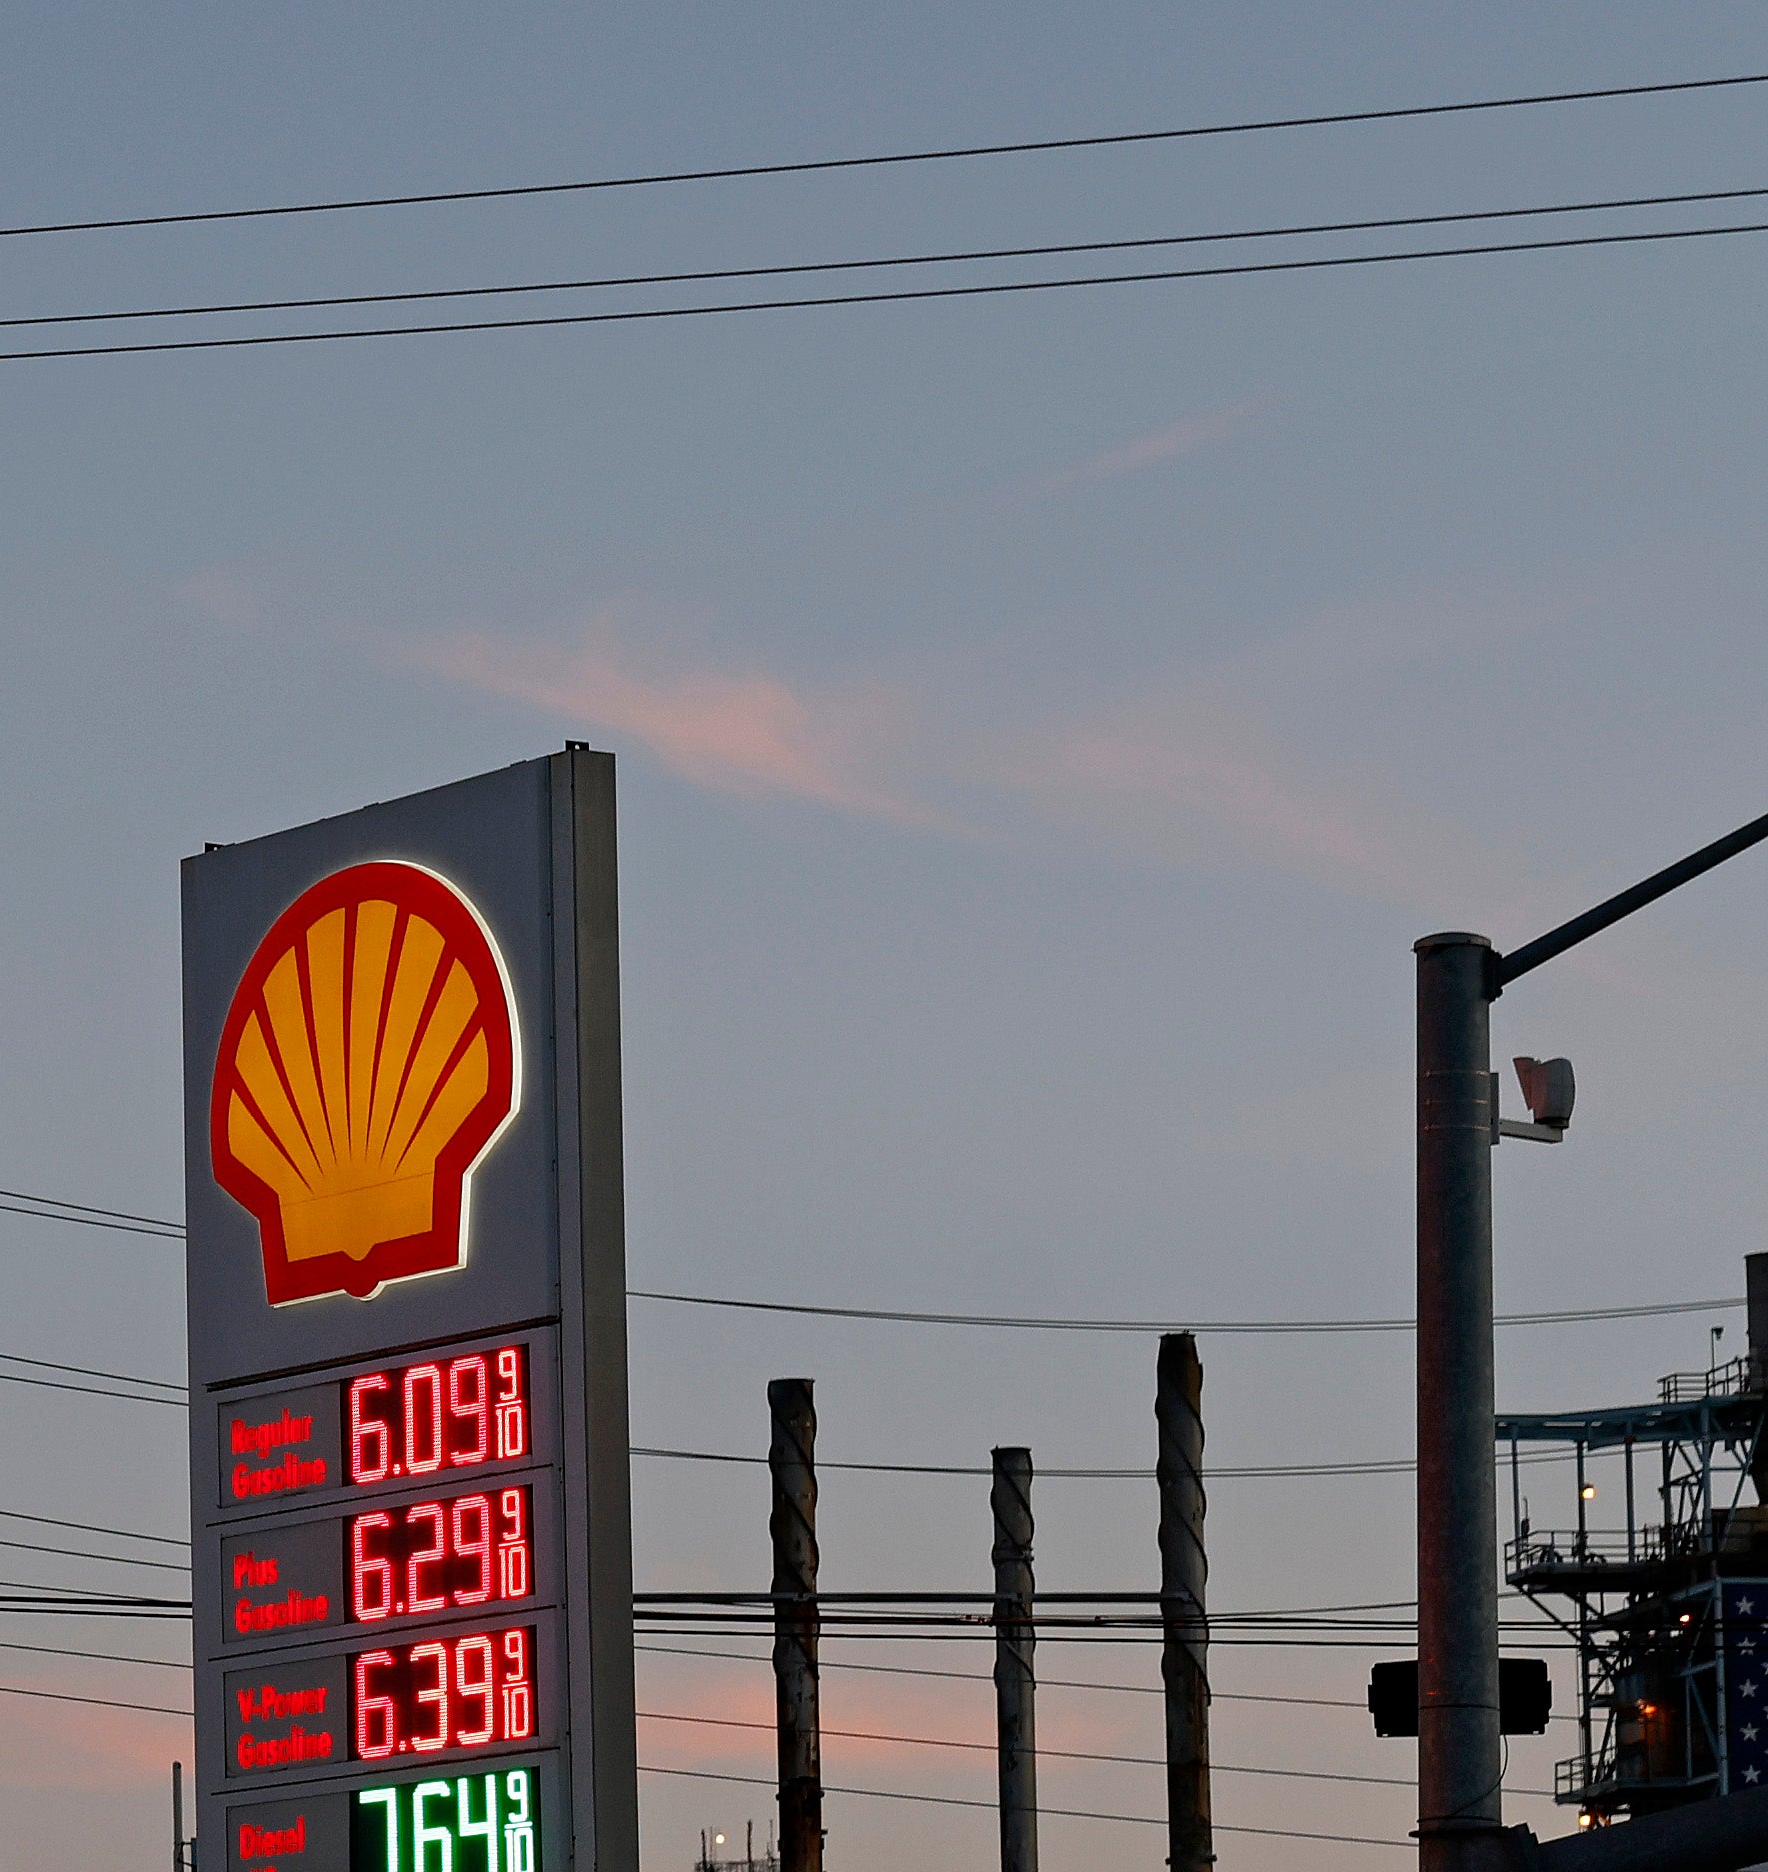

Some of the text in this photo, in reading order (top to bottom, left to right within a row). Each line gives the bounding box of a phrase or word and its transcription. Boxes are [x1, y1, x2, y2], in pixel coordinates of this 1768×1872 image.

[231, 1408, 313, 1458] Regular
[350, 1356, 486, 1484] 6.09
[232, 1453, 327, 1499] Gasoline
[234, 1551, 278, 1588] Plus
[353, 1495, 490, 1621] 6.29
[234, 1588, 328, 1633] Gasoline
[237, 1685, 328, 1723] V-Power
[356, 1635, 493, 1759] 6.39
[237, 1724, 333, 1769] Gasoline
[239, 1814, 305, 1860] Diesel
